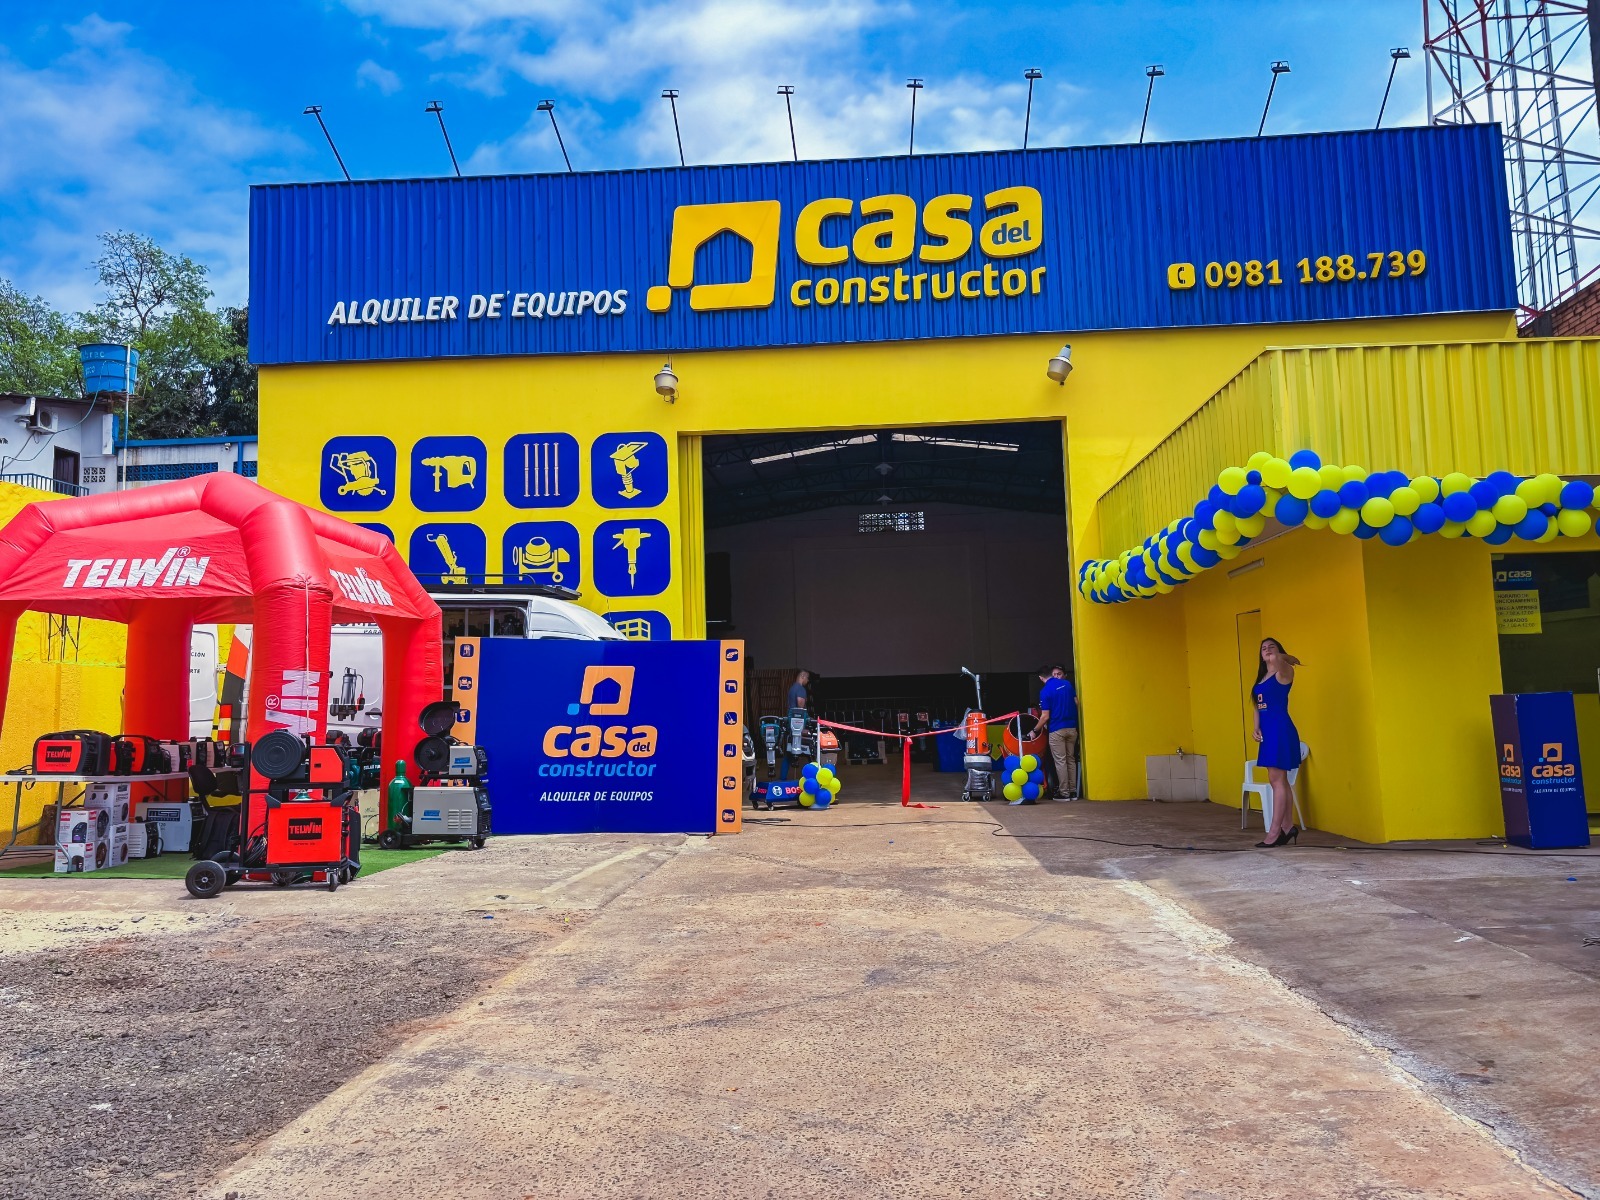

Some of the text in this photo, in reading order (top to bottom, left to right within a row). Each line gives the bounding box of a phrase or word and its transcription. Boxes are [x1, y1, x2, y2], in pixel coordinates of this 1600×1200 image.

[795, 185, 1043, 265] casa del
[1204, 249, 1427, 288] 0981 188.739
[790, 262, 1047, 307] constructor
[327, 289, 628, 326] ALQUILER DE EQUIPOS
[543, 725, 658, 758] casa del
[538, 761, 657, 777] constructor
[1531, 777, 1576, 785] constructor
[1532, 763, 1575, 778] casa
[540, 792, 654, 802] ALQUILER DE EQUIPOS
[785, 786, 802, 795] BOS
